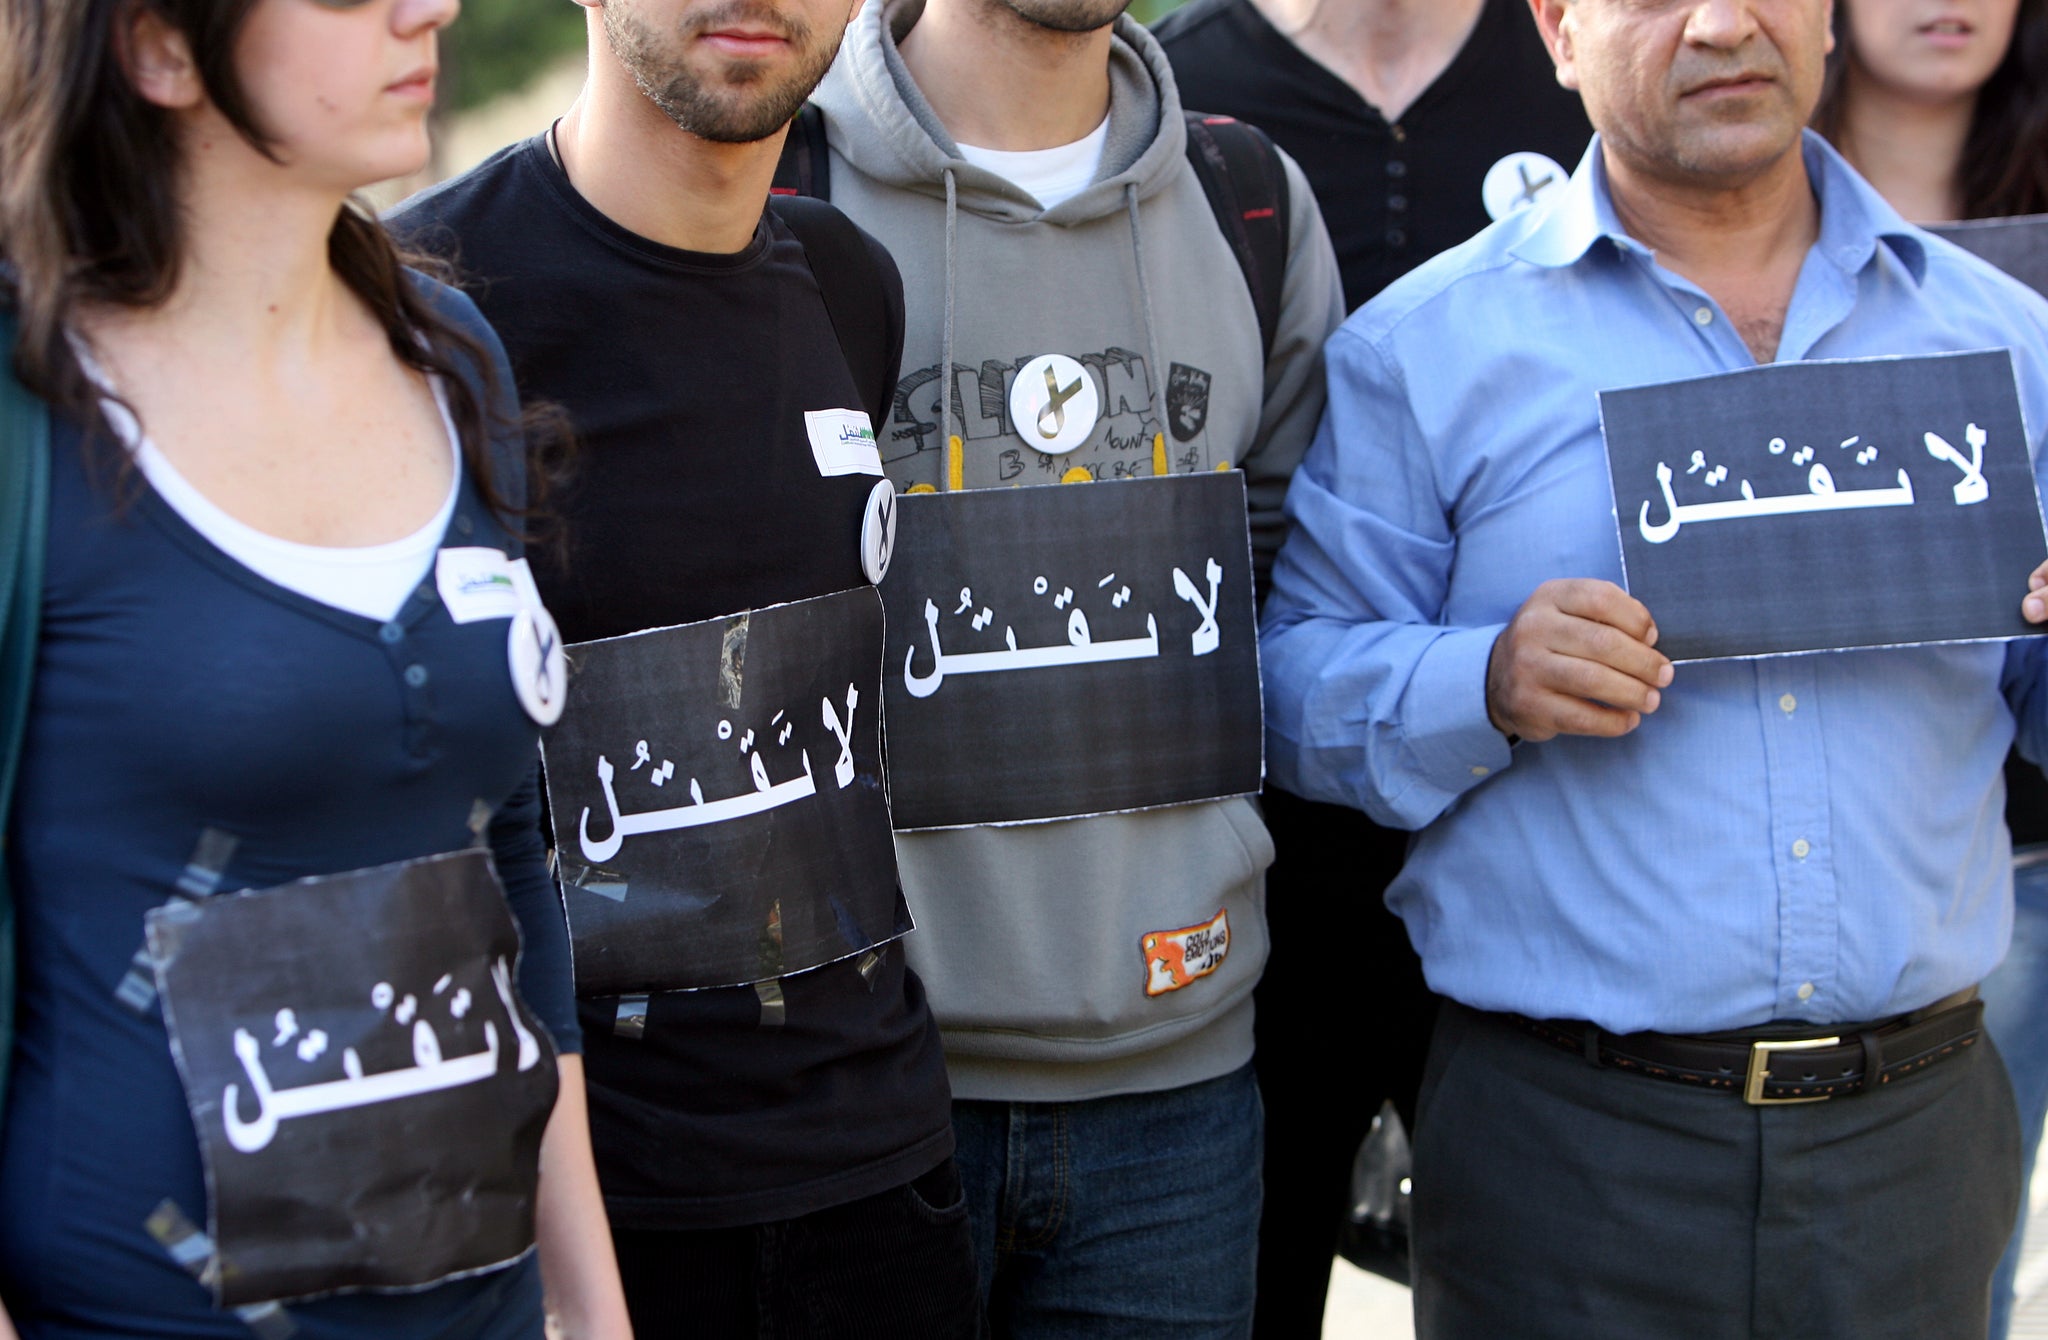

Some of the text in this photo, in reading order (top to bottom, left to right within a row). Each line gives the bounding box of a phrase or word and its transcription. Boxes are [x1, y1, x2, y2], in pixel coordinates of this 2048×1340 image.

[1924, 423, 1989, 506] لا
[1172, 557, 1223, 656] لا
[822, 682, 859, 790] لا
